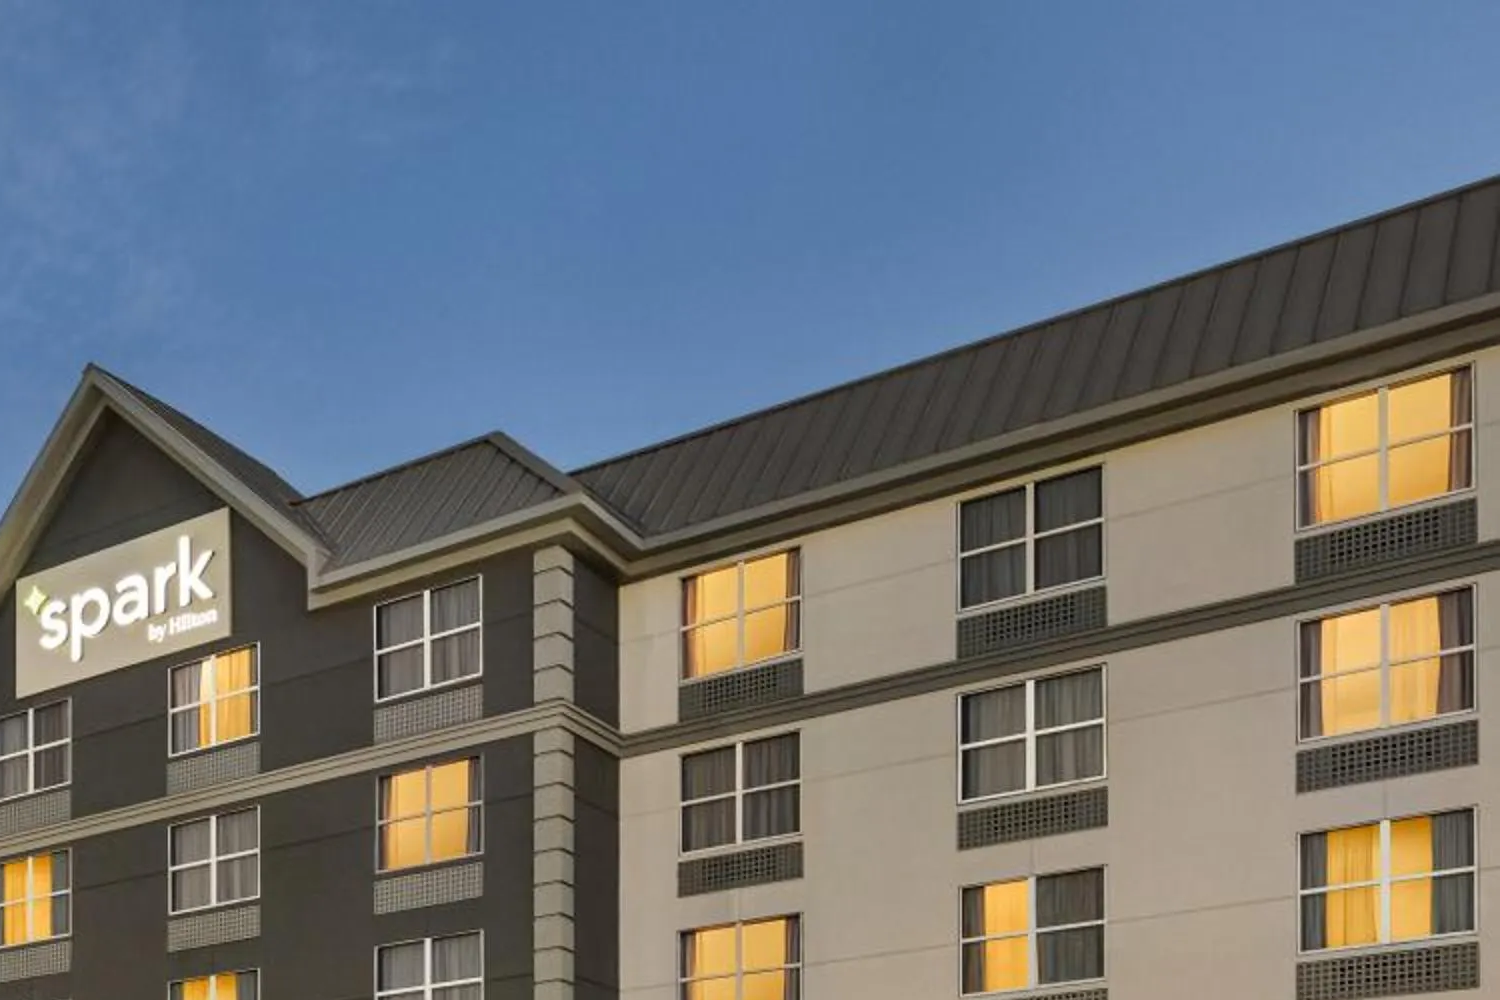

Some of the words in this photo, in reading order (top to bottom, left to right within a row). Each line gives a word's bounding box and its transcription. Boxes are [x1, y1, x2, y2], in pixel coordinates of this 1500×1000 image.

[39, 535, 214, 662] spark
[147, 623, 166, 642] by
[169, 608, 218, 635] Hilton
